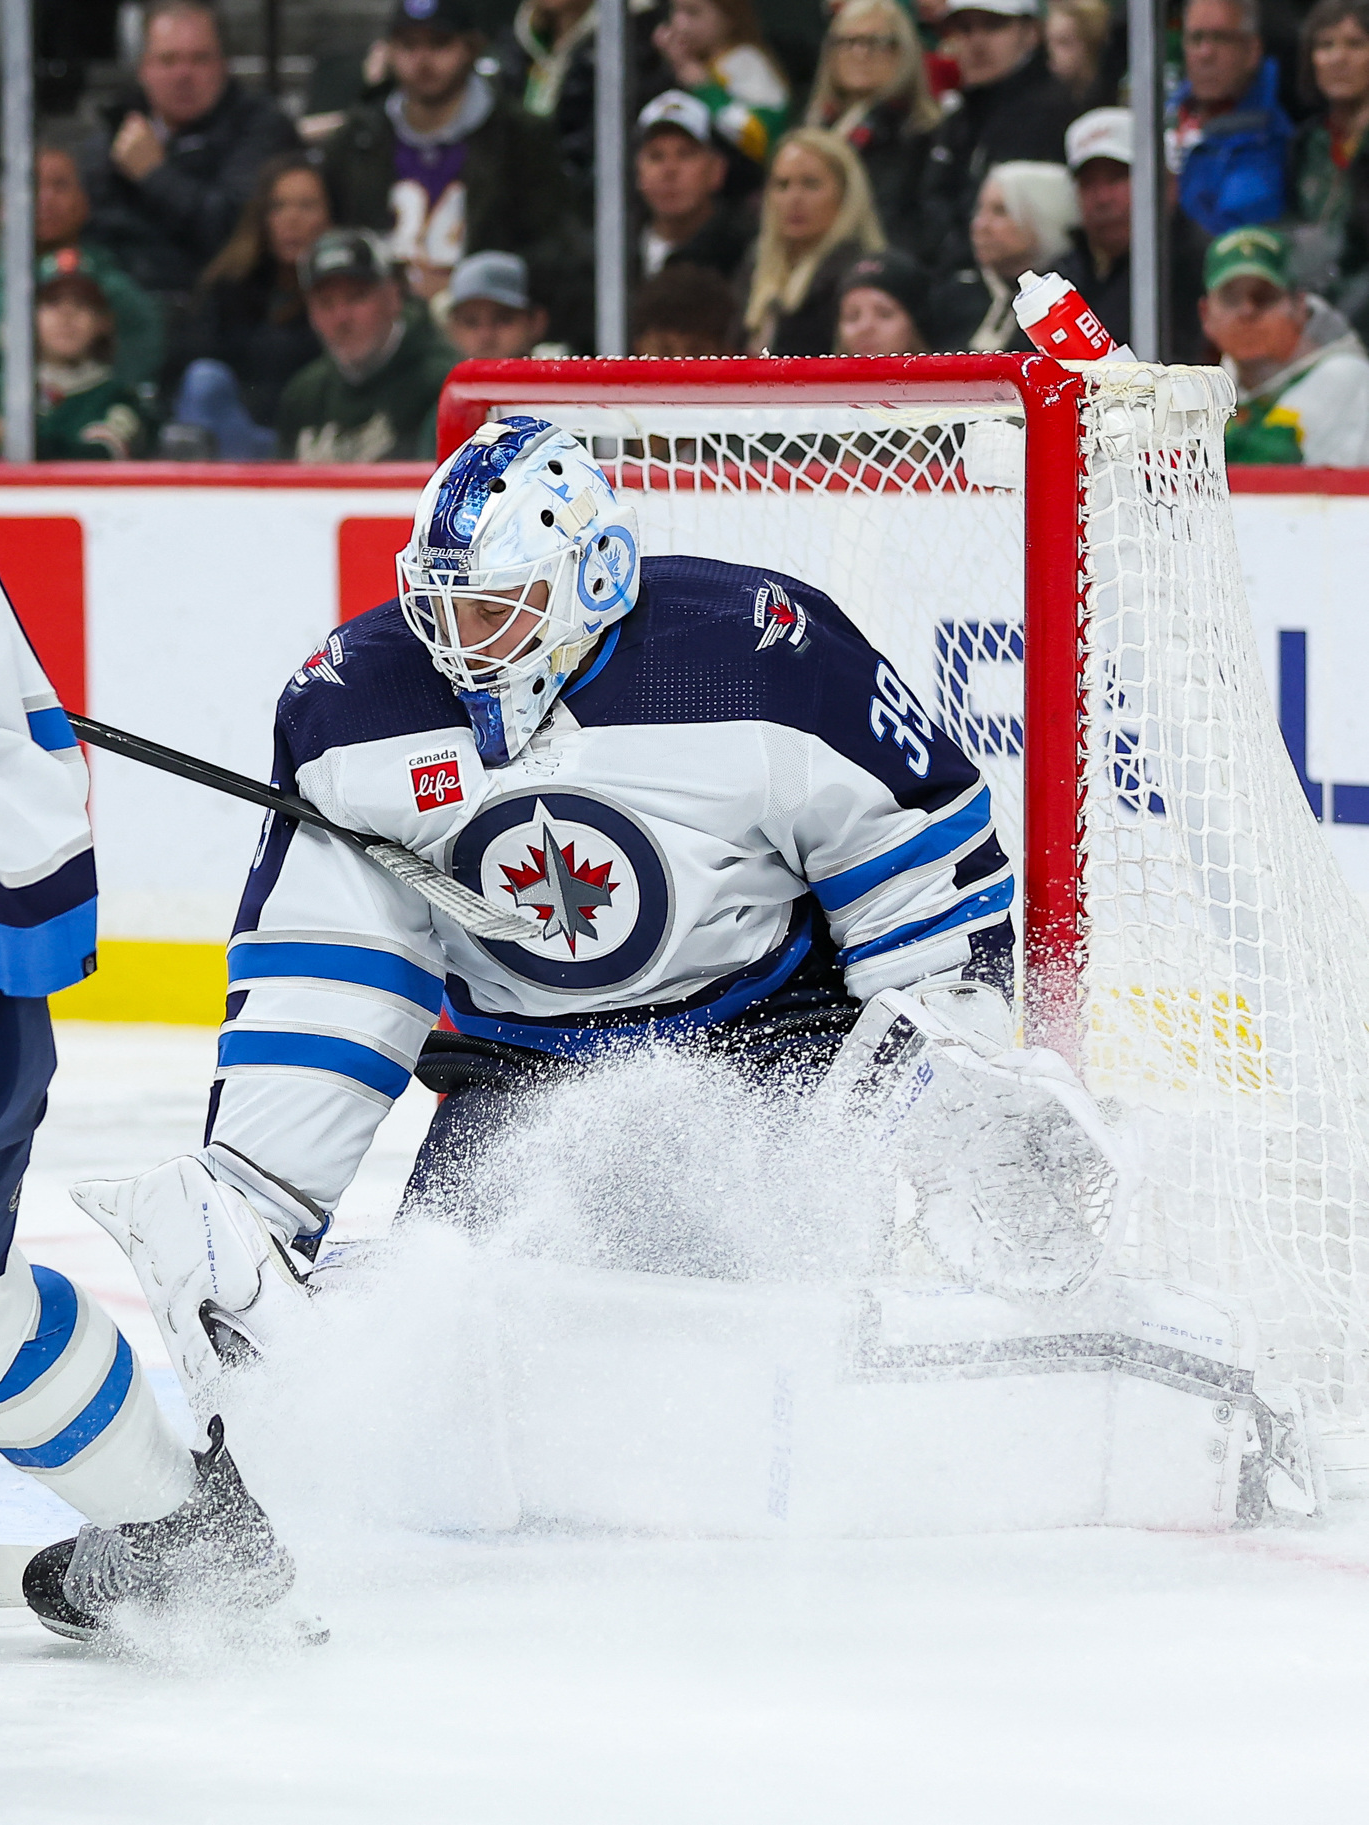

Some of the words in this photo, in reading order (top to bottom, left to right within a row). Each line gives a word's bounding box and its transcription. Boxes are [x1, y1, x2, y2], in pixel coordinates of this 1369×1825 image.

[756, 589, 768, 624] WINNIPEG
[868, 659, 935, 779] 39
[408, 749, 458, 767] canada
[414, 769, 461, 802] life
